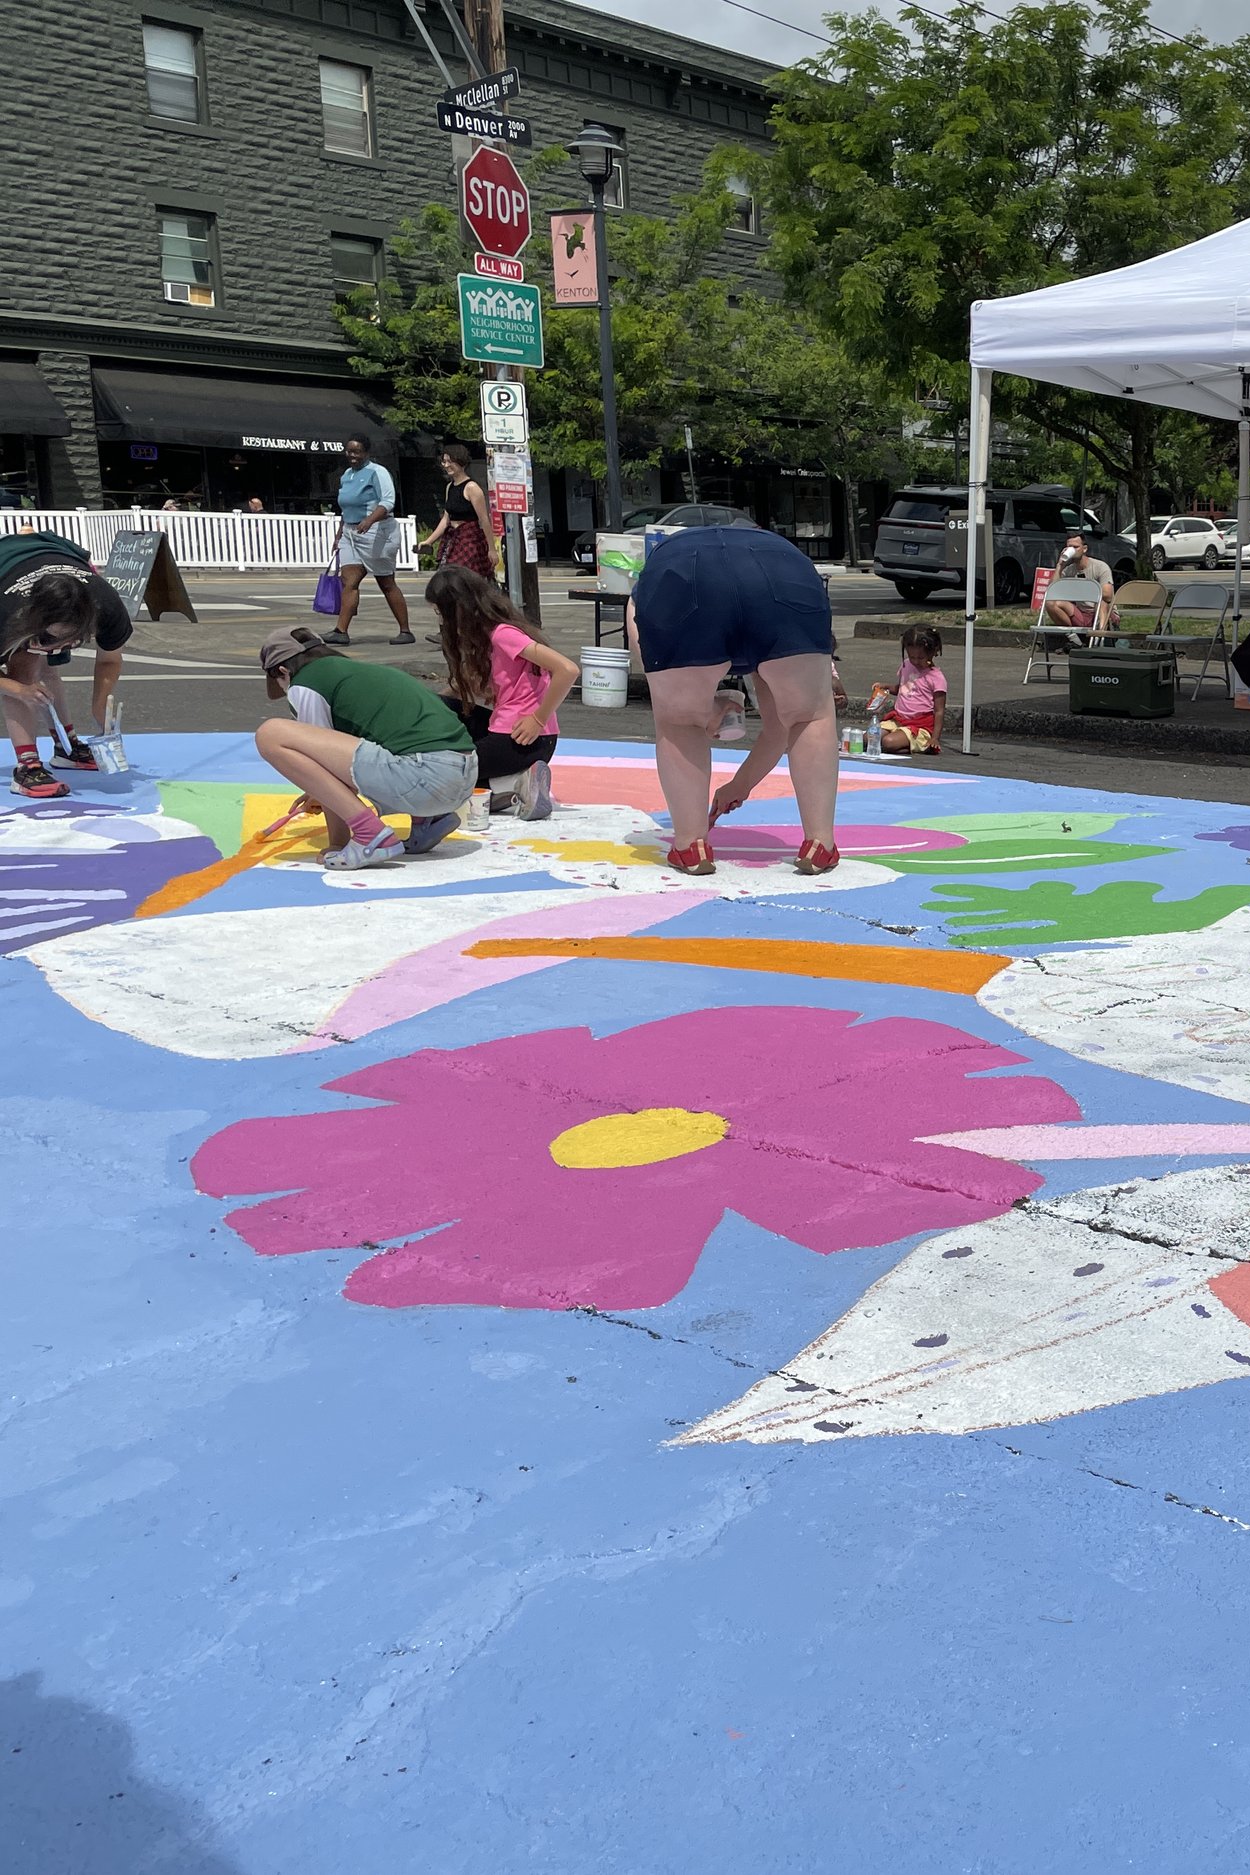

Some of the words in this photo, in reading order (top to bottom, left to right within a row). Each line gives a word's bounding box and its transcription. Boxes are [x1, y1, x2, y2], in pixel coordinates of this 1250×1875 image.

[456, 84, 499, 106] McClellan
[444, 115, 451, 126] N
[456, 112, 503, 135] Denver
[508, 121, 525, 132] 2000
[510, 130, 518, 138] Av
[469, 176, 525, 227] STOP
[480, 259, 498, 272] ALL
[500, 263, 519, 277] WAY
[557, 288, 596, 298] KENTON
[470, 317, 535, 334] NEIGHBORHOOD
[471, 328, 504, 340] SERVICE
[506, 333, 535, 344] CENTER
[502, 418, 506, 427] 1
[242, 436, 306, 450] RESTAURANT
[310, 441, 320, 450] &
[323, 442, 344, 452] PUB
[958, 520, 968, 529] Exi
[114, 541, 137, 553] Street
[113, 554, 145, 580] Painting
[1092, 676, 1120, 684] IGLOO
